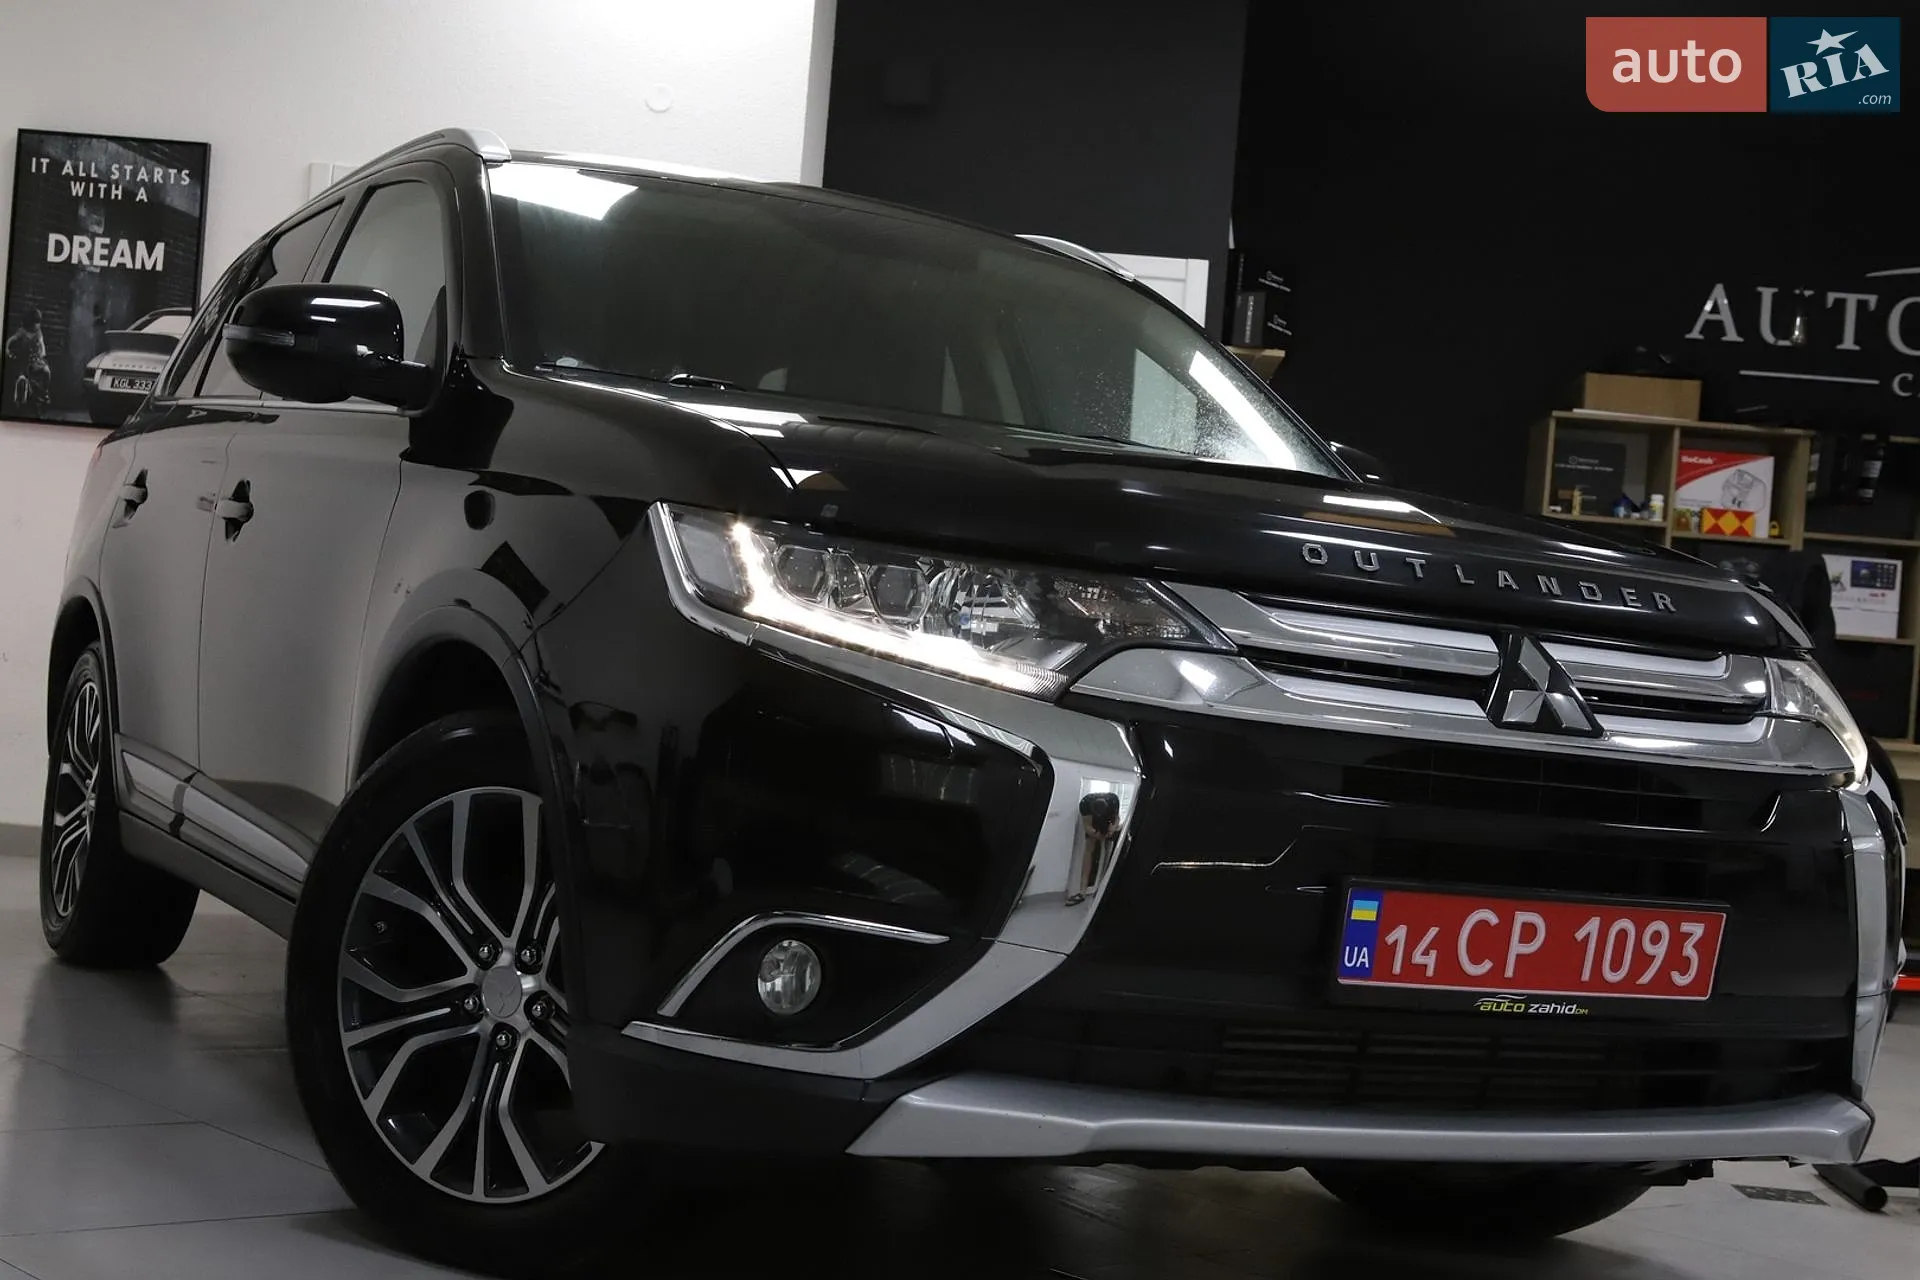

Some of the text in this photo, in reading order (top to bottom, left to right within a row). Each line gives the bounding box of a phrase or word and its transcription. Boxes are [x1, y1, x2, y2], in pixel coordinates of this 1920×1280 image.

[31, 156, 192, 186] IT ALL STARTS
[70, 180, 149, 203] WITH A
[46, 232, 166, 272] DREAM
[1301, 542, 1677, 614] OUTLANDER
[1344, 946, 1370, 969] UA
[1384, 908, 1706, 988] 14 CP 1093
[1479, 1001, 1526, 1013] auto
